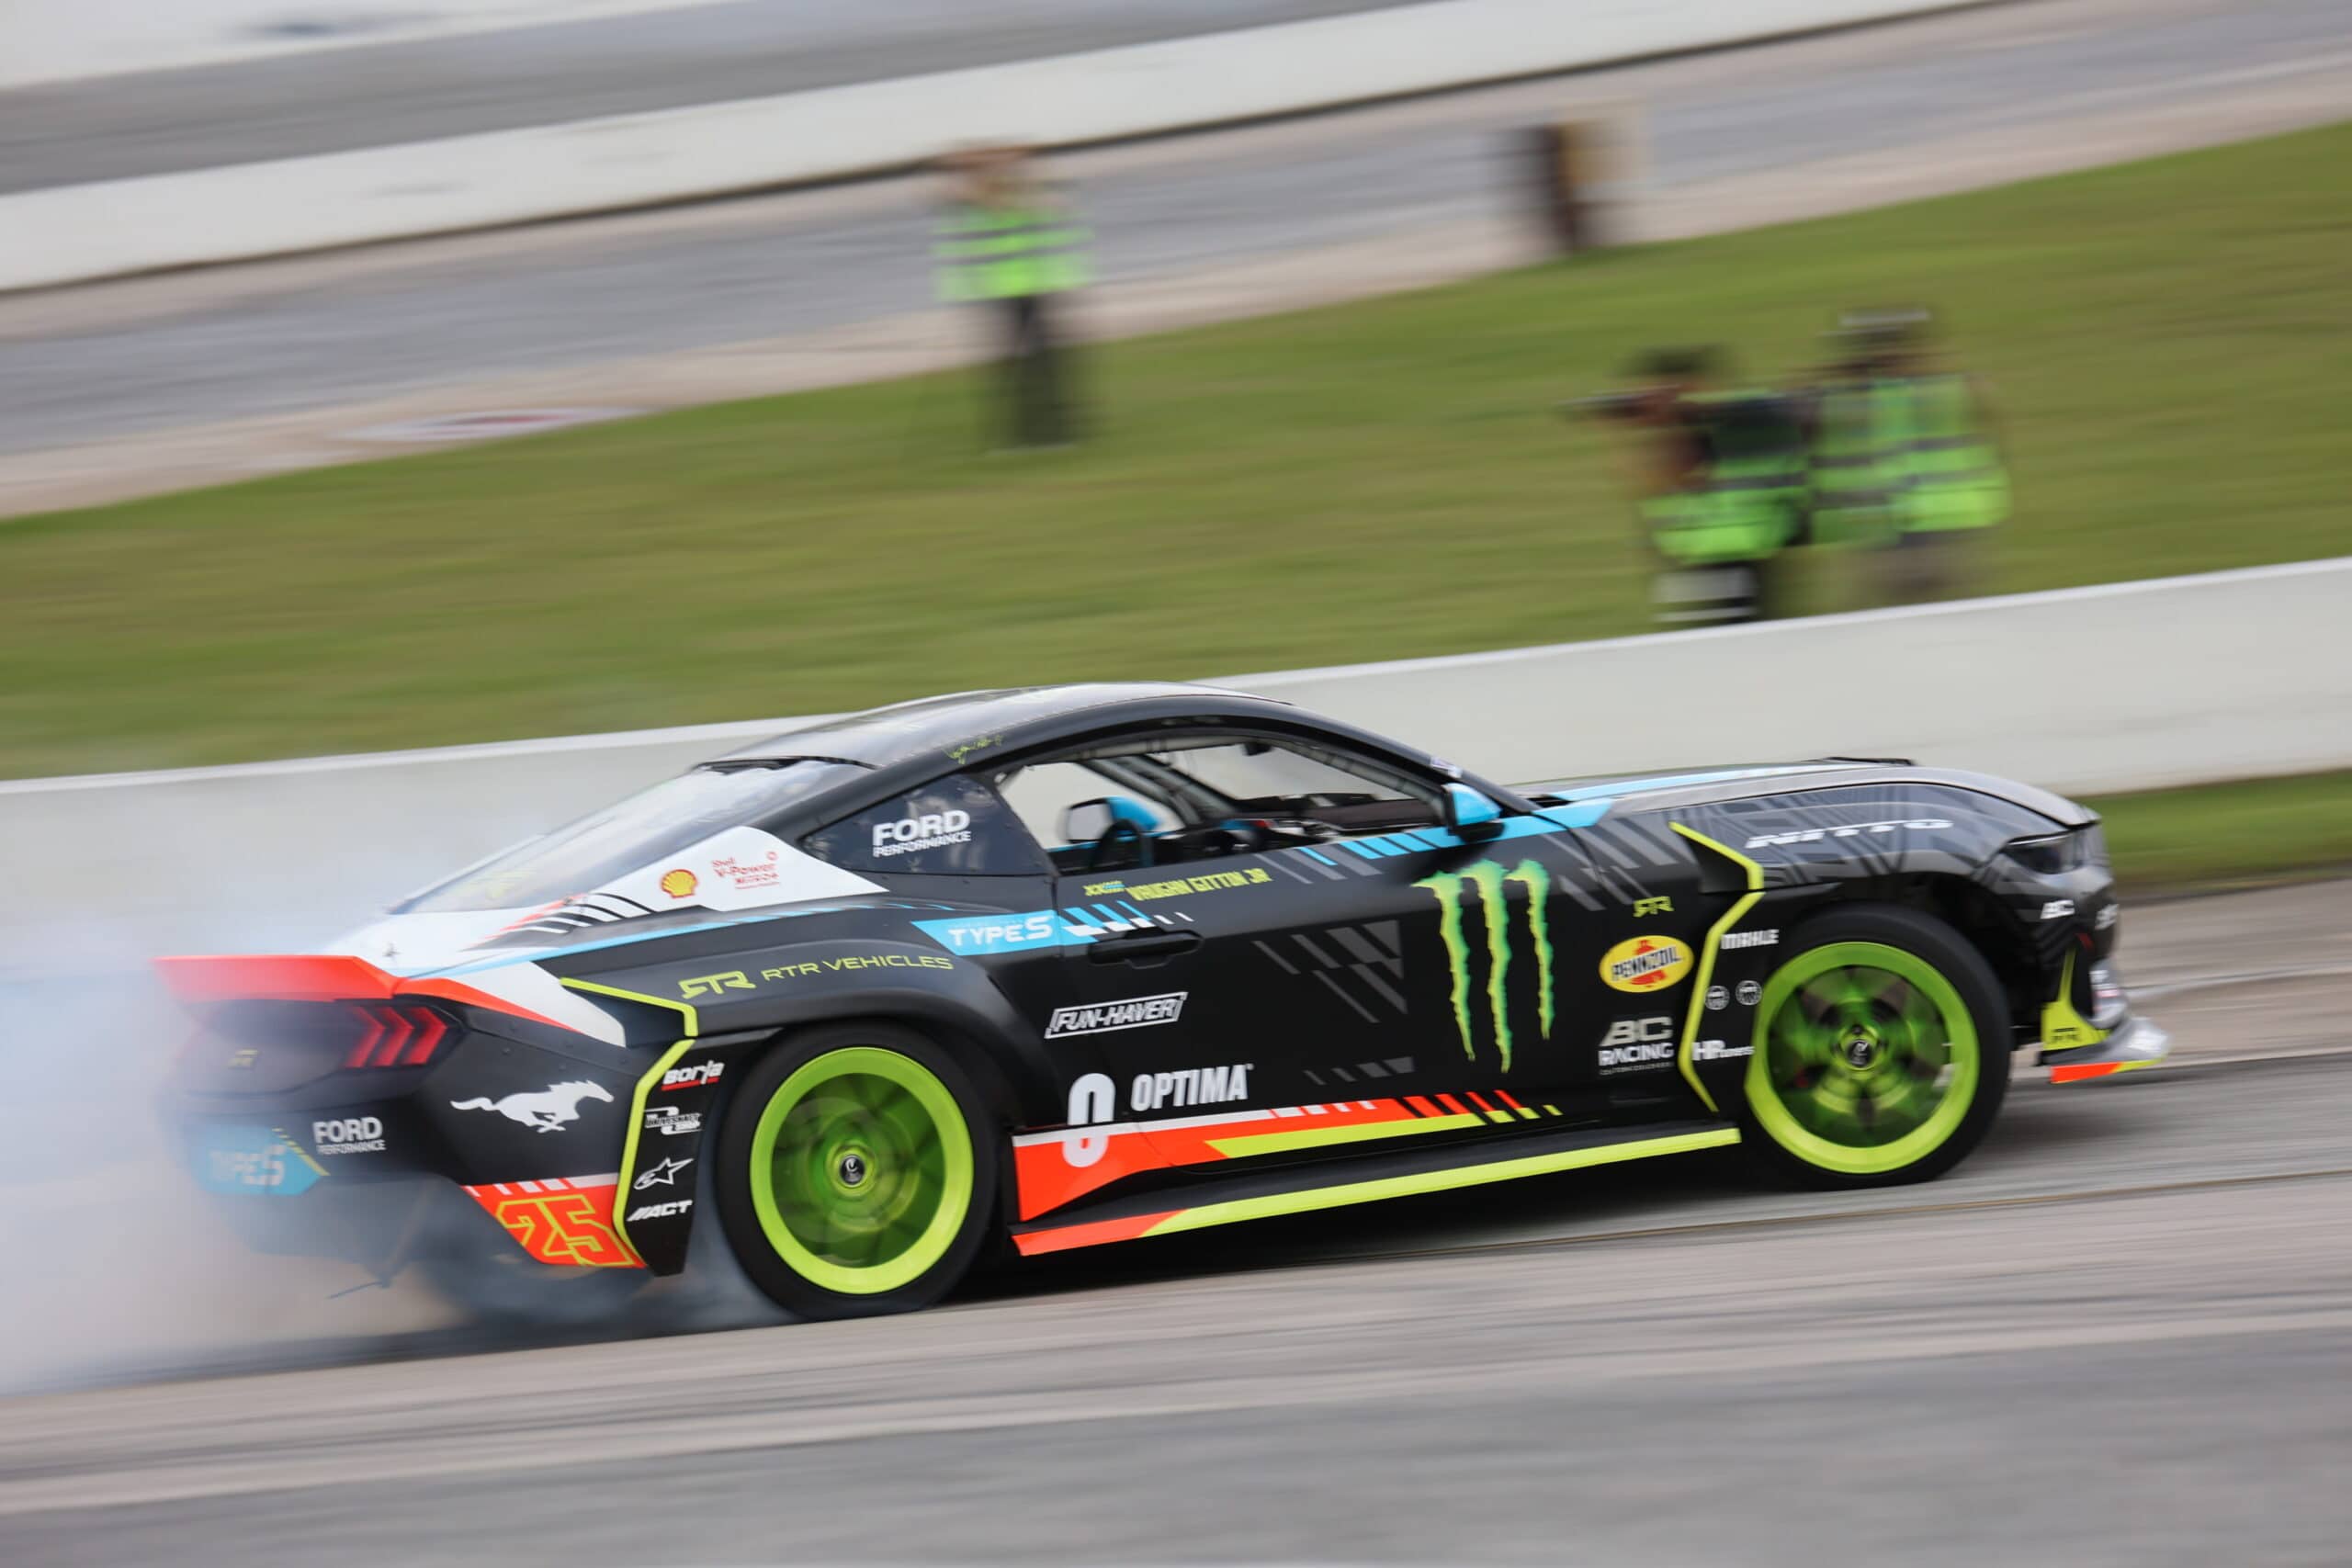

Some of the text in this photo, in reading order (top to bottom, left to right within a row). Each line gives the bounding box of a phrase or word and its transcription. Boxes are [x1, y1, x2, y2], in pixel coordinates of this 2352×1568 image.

[873, 809, 971, 846] FORD
[872, 830, 972, 858] PERFORMANCE
[761, 955, 955, 981] RTR VEHICLES
[1611, 946, 1683, 981] PENNZOIL
[1053, 998, 1180, 1032] FUN-HAVER
[1598, 1042, 1674, 1066] RACING
[1130, 1066, 1248, 1111] OPTIMA
[312, 1116, 383, 1144] FORD
[316, 1139, 386, 1155] PERFORMANCE
[496, 1194, 635, 1267] 25
